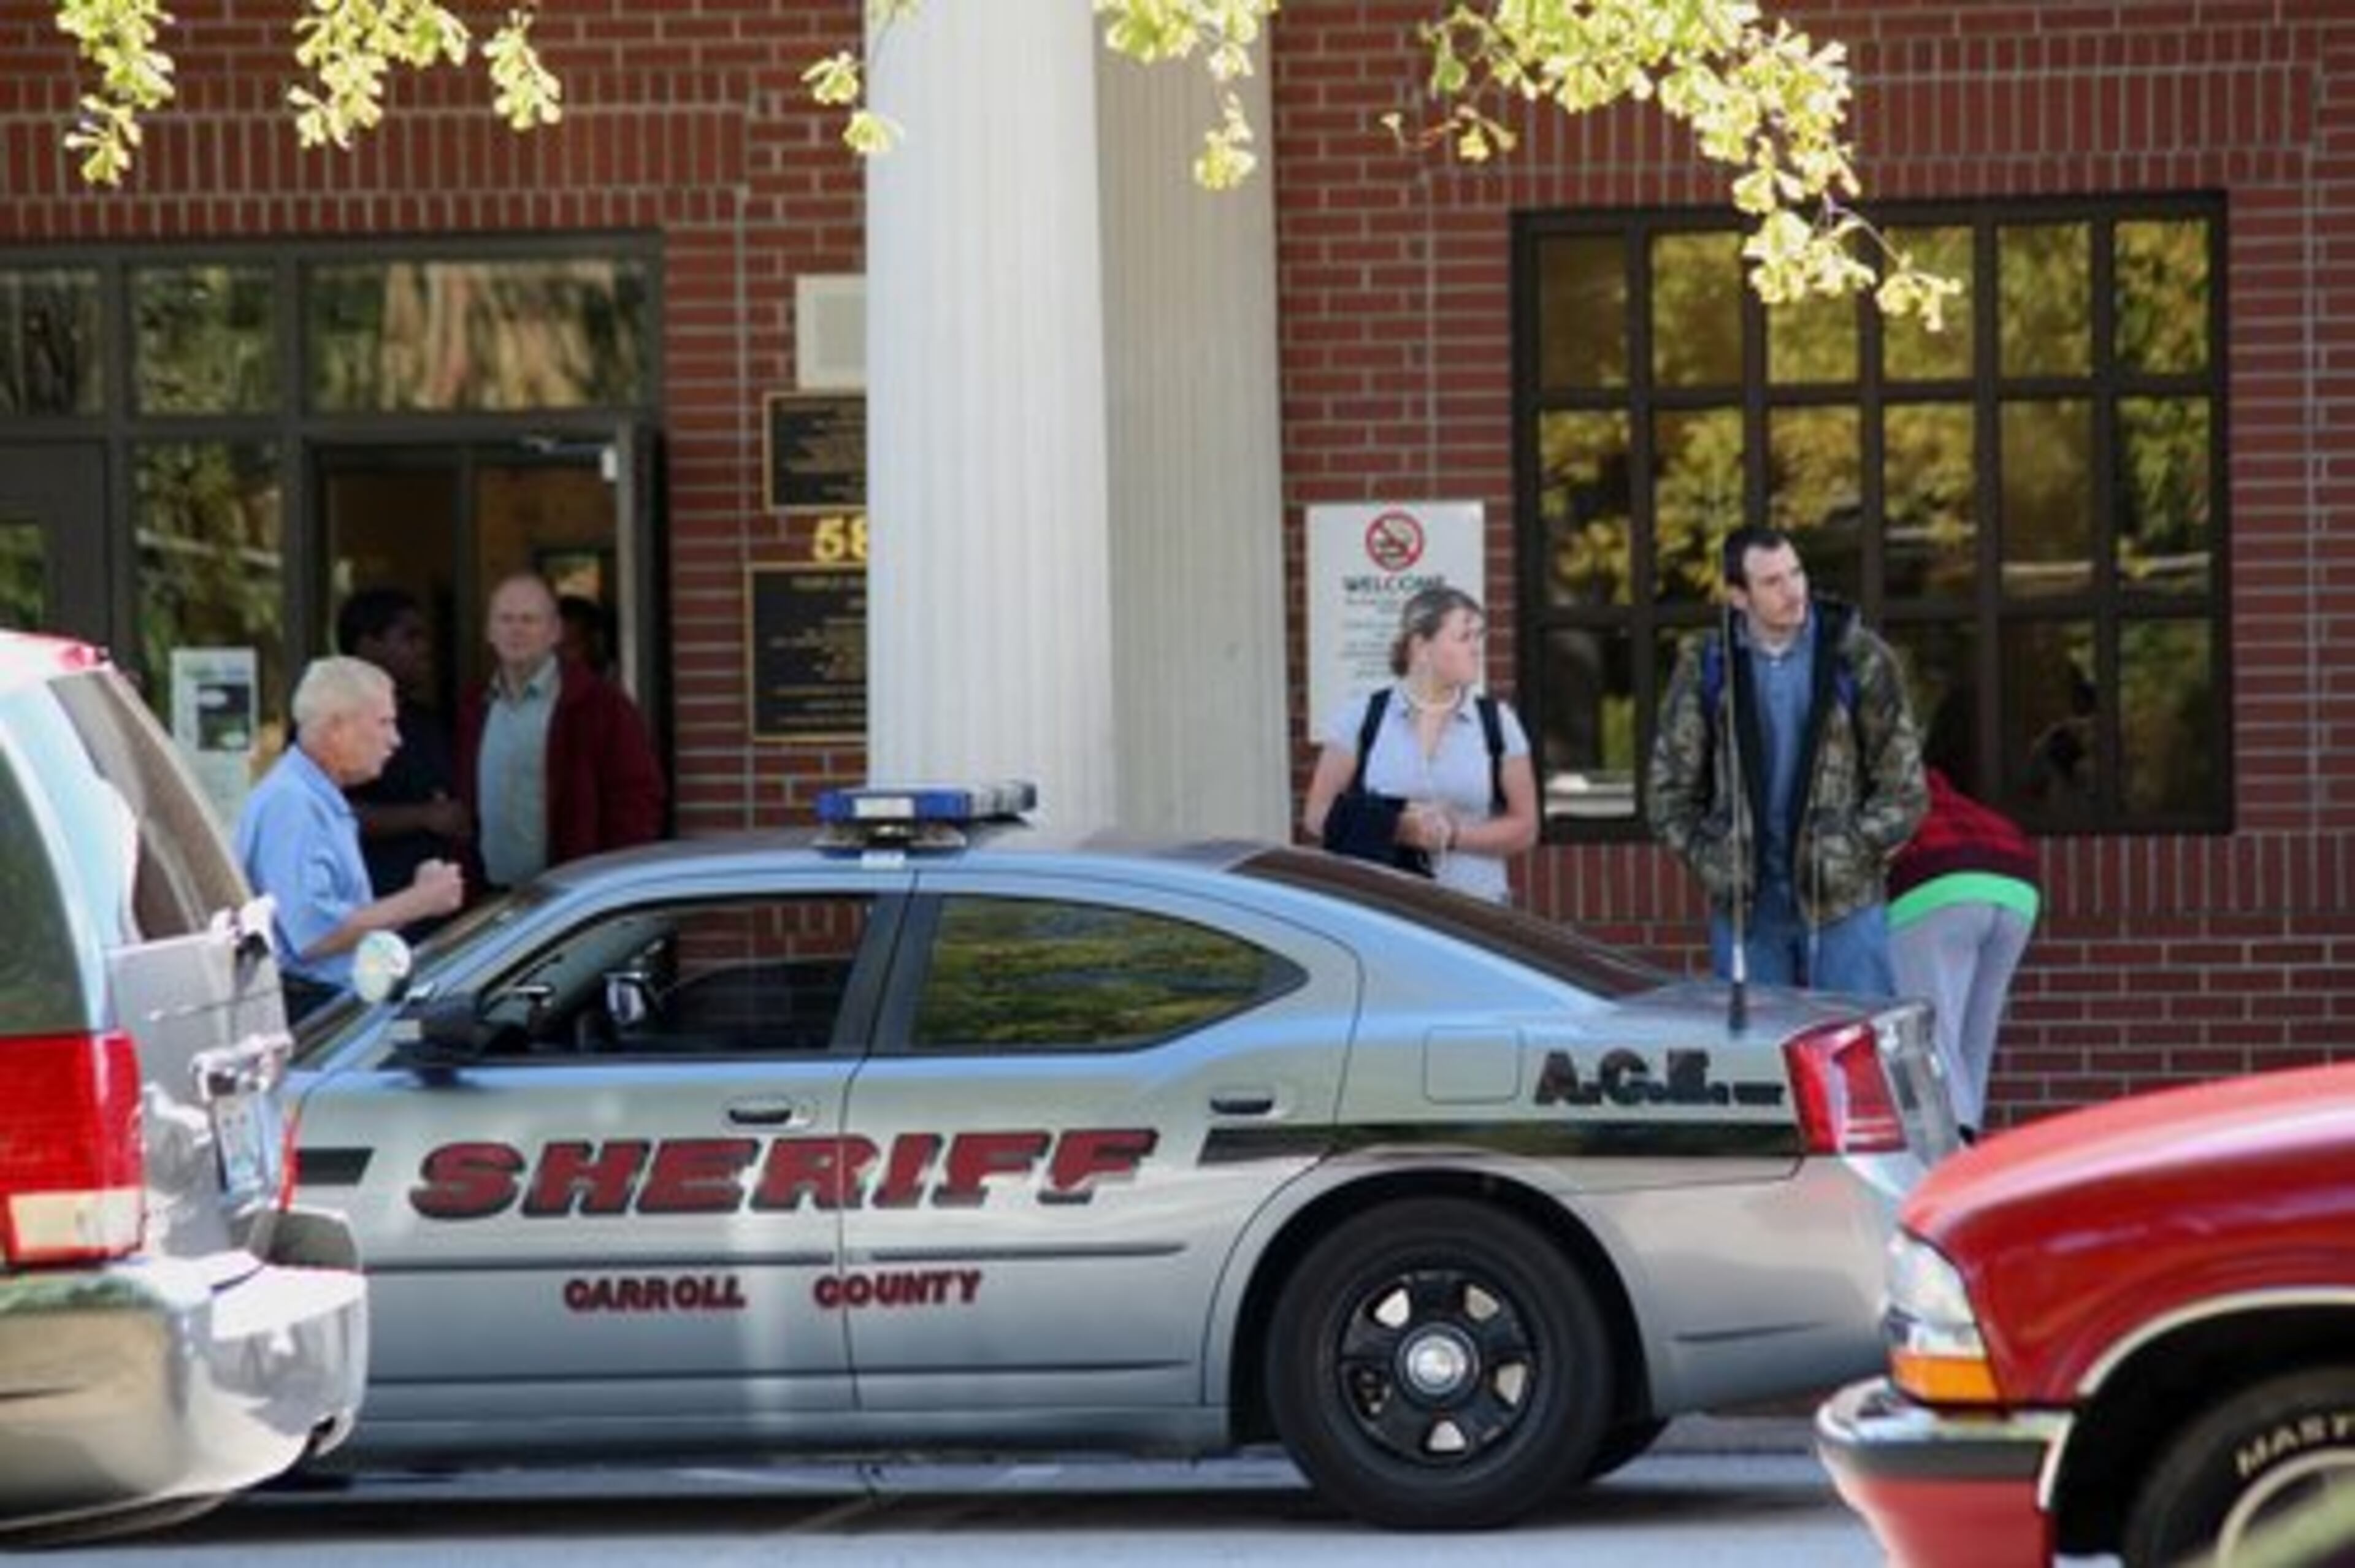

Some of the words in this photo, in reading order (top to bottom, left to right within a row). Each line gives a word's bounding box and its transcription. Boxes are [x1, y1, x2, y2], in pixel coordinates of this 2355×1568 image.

[409, 1128, 1158, 1218] SHERIFF
[563, 1274, 746, 1311] CARROLL
[813, 1271, 982, 1307] COUNTY
